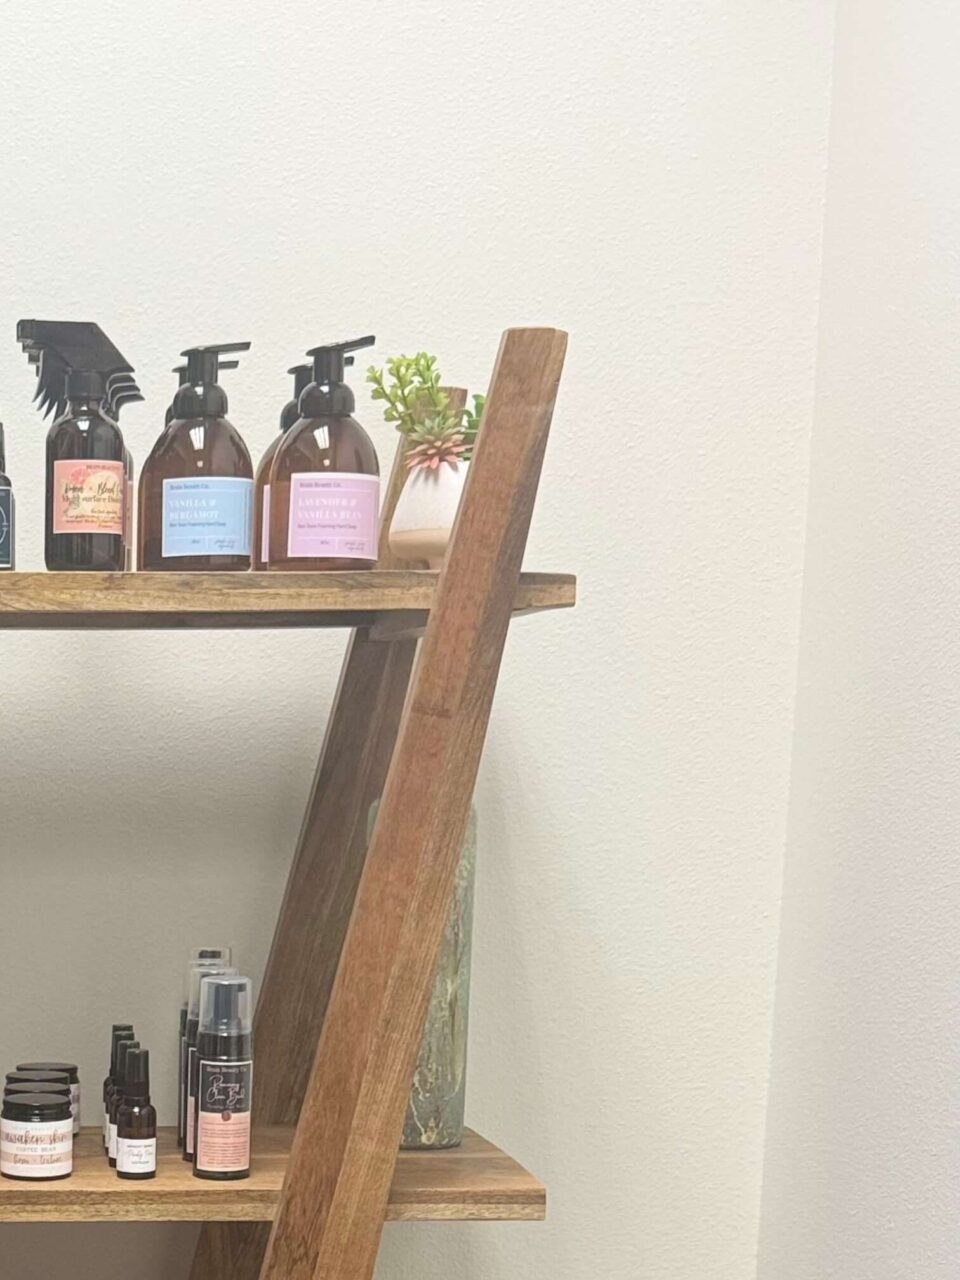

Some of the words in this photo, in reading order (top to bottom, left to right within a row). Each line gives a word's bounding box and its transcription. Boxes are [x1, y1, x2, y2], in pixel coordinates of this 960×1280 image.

[168, 499, 207, 508] VANILLA
[298, 498, 348, 507] LAVENDER
[169, 511, 219, 520] BERGAMOT
